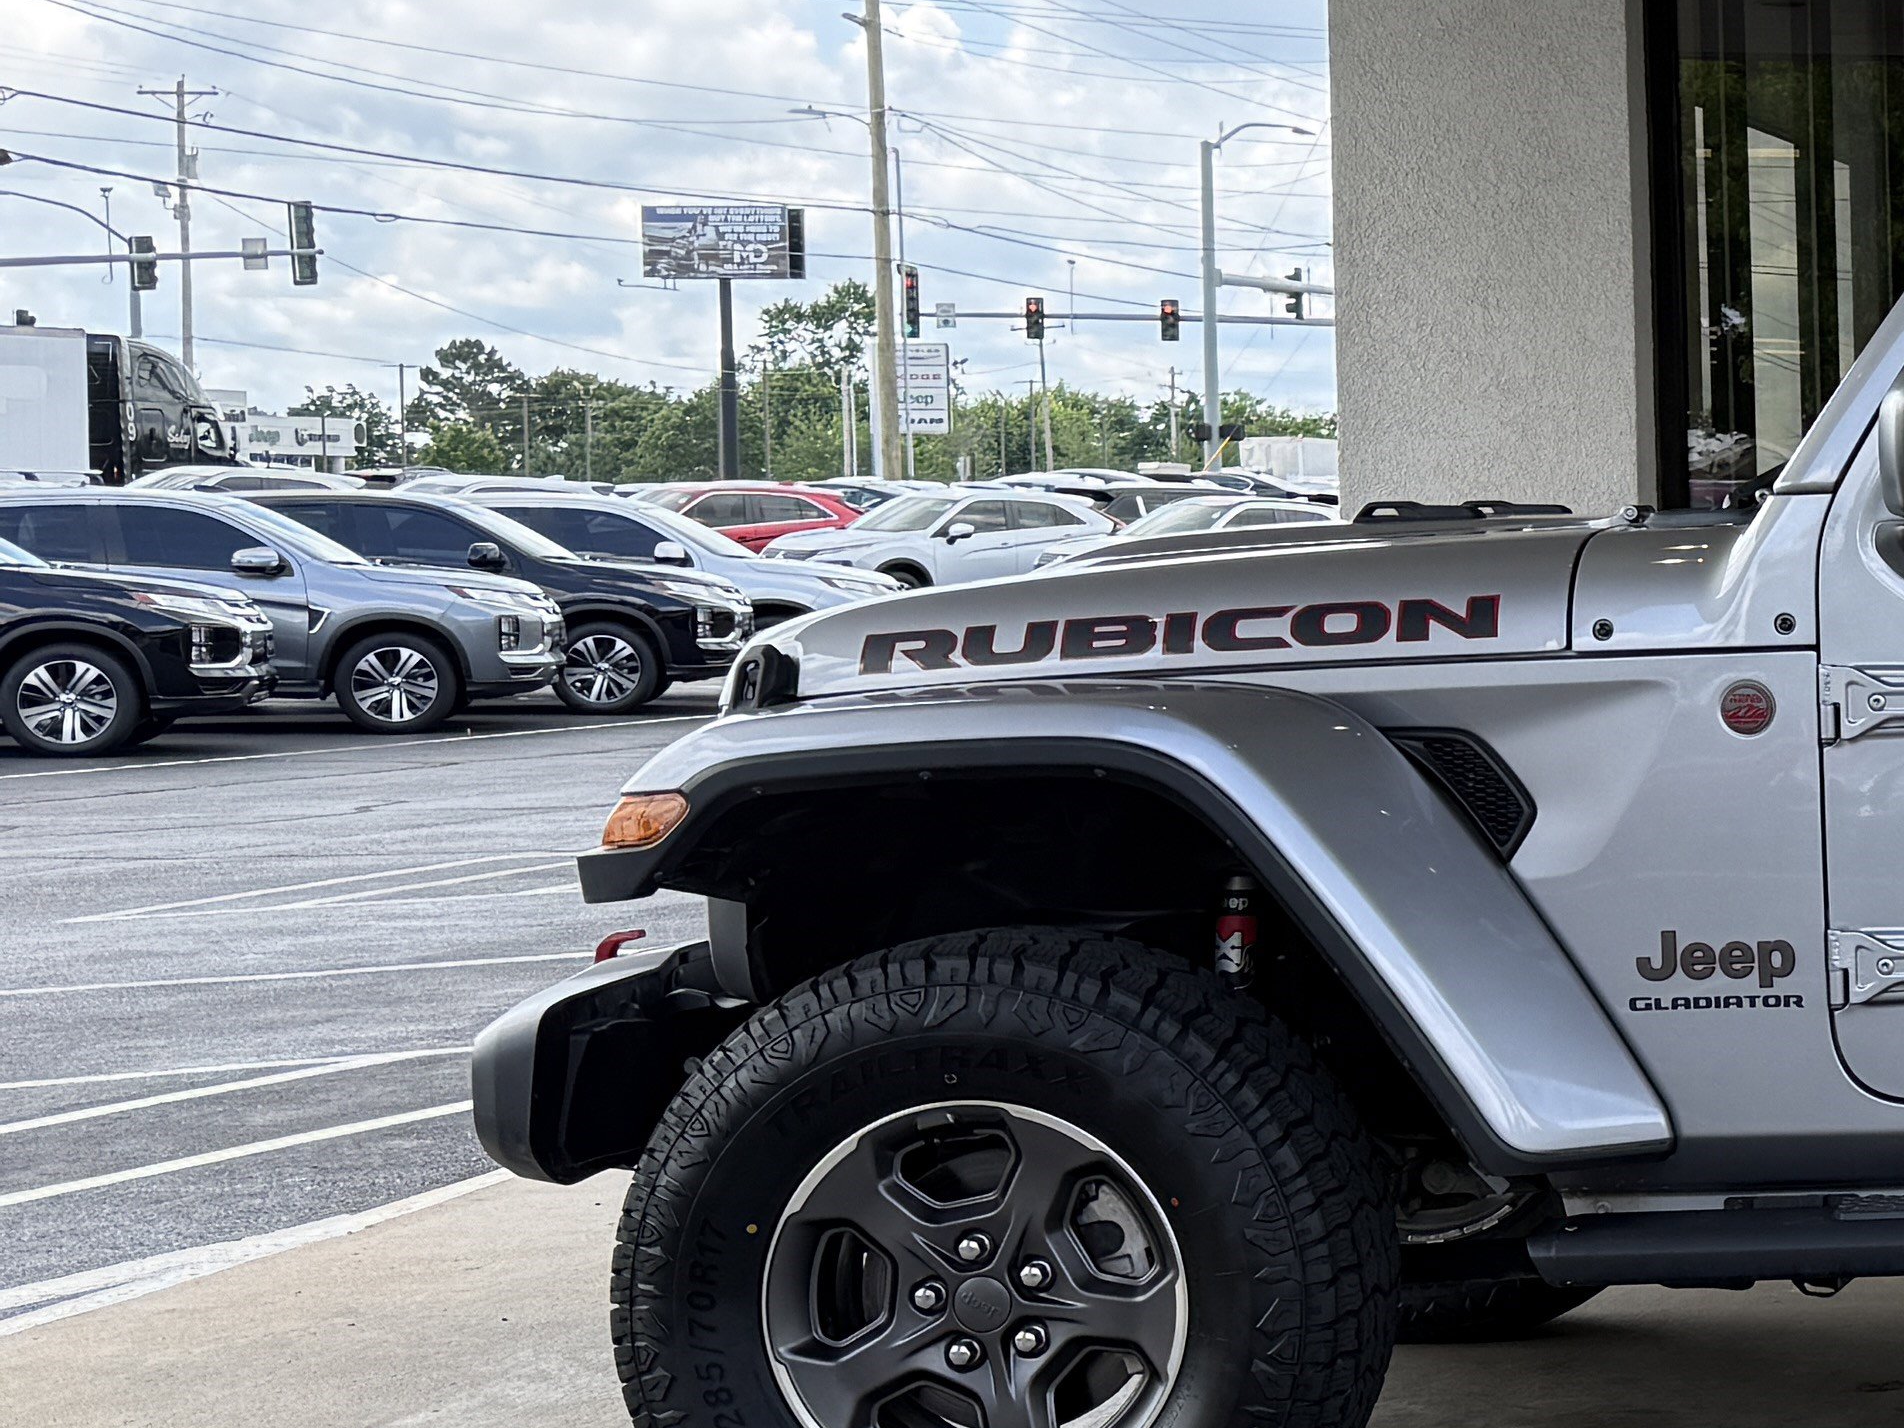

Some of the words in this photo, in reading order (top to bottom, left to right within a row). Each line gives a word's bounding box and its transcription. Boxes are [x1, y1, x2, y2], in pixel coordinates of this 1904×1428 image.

[858, 594, 1501, 673] RUBICON
[1636, 930, 1796, 989] Jeep
[1629, 995, 1804, 1012] GLADIATOR
